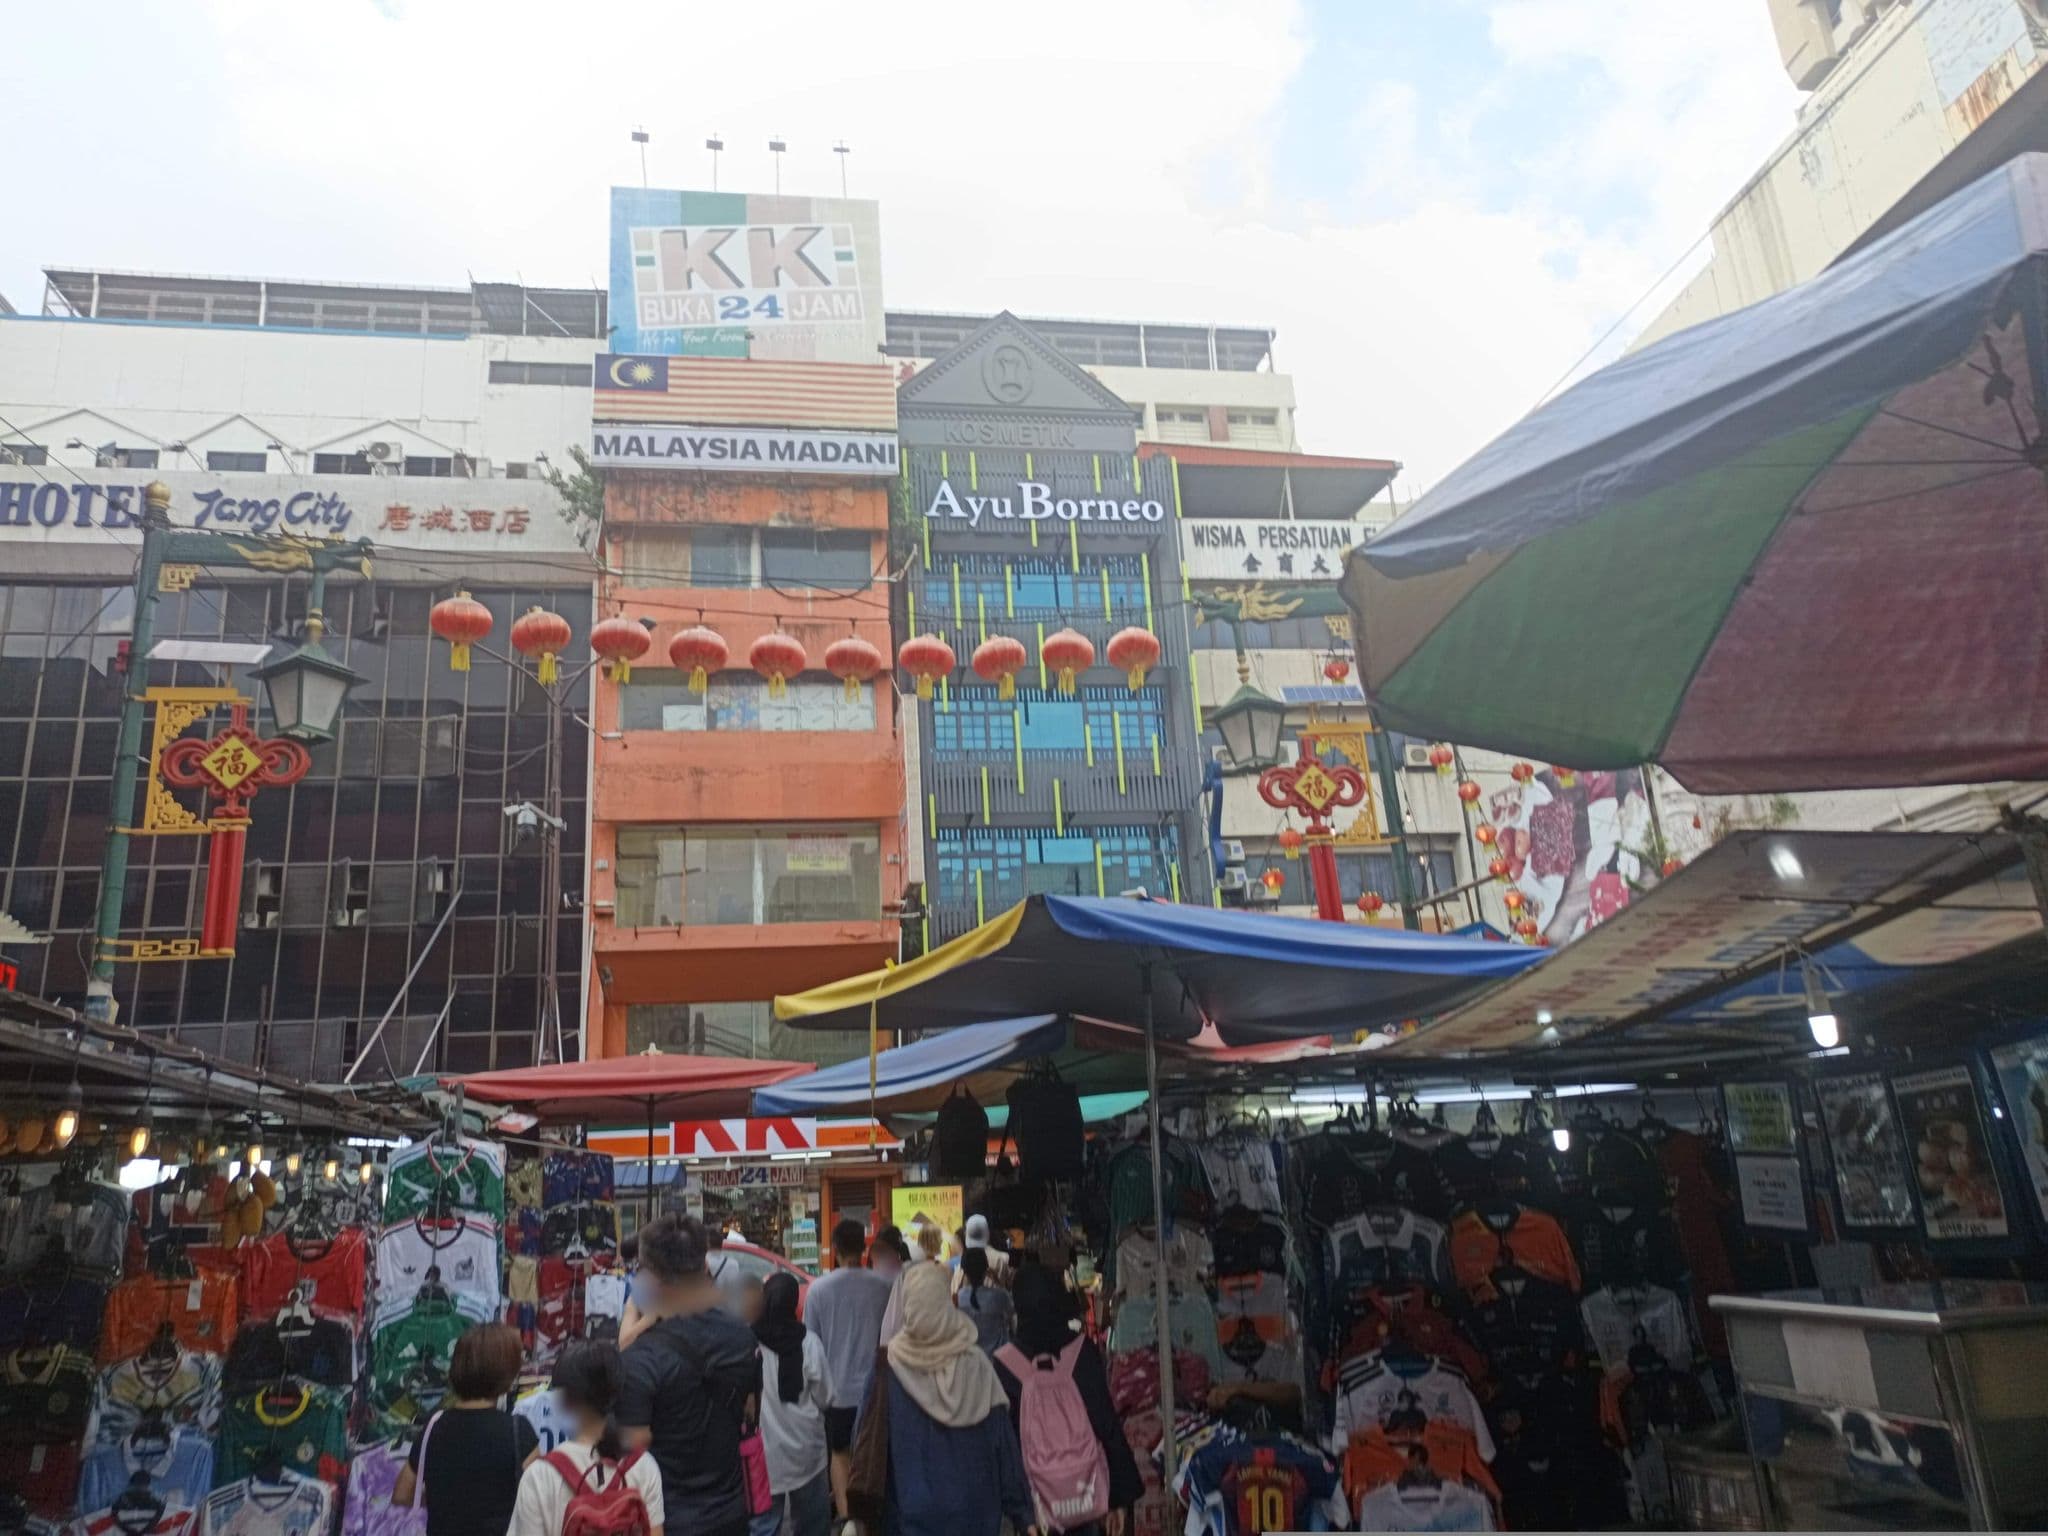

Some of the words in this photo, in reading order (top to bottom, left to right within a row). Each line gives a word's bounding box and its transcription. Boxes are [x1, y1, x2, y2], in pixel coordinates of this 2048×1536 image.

[659, 226, 832, 290] KK
[643, 298, 713, 324] BUKA
[718, 294, 784, 320] 24
[792, 293, 858, 319] JAM
[594, 434, 763, 460] MALAYSIA
[769, 439, 896, 465] MADANI
[944, 422, 1075, 447] KOSMETIK
[0, 482, 147, 528] HOTE
[284, 491, 353, 533] City
[378, 503, 530, 534] 唐城酒店
[925, 481, 1013, 527] Ayu
[1018, 482, 1164, 522] Borneo
[1192, 524, 1246, 548] WISMA
[1258, 525, 1352, 549] PERSATUAN
[213, 746, 247, 777] 福
[1302, 775, 1328, 799] 福
[708, 1170, 738, 1185] BUKA
[741, 1166, 769, 1184] 24
[773, 1167, 801, 1183] JAM
[1245, 1486, 1285, 1532] 10
